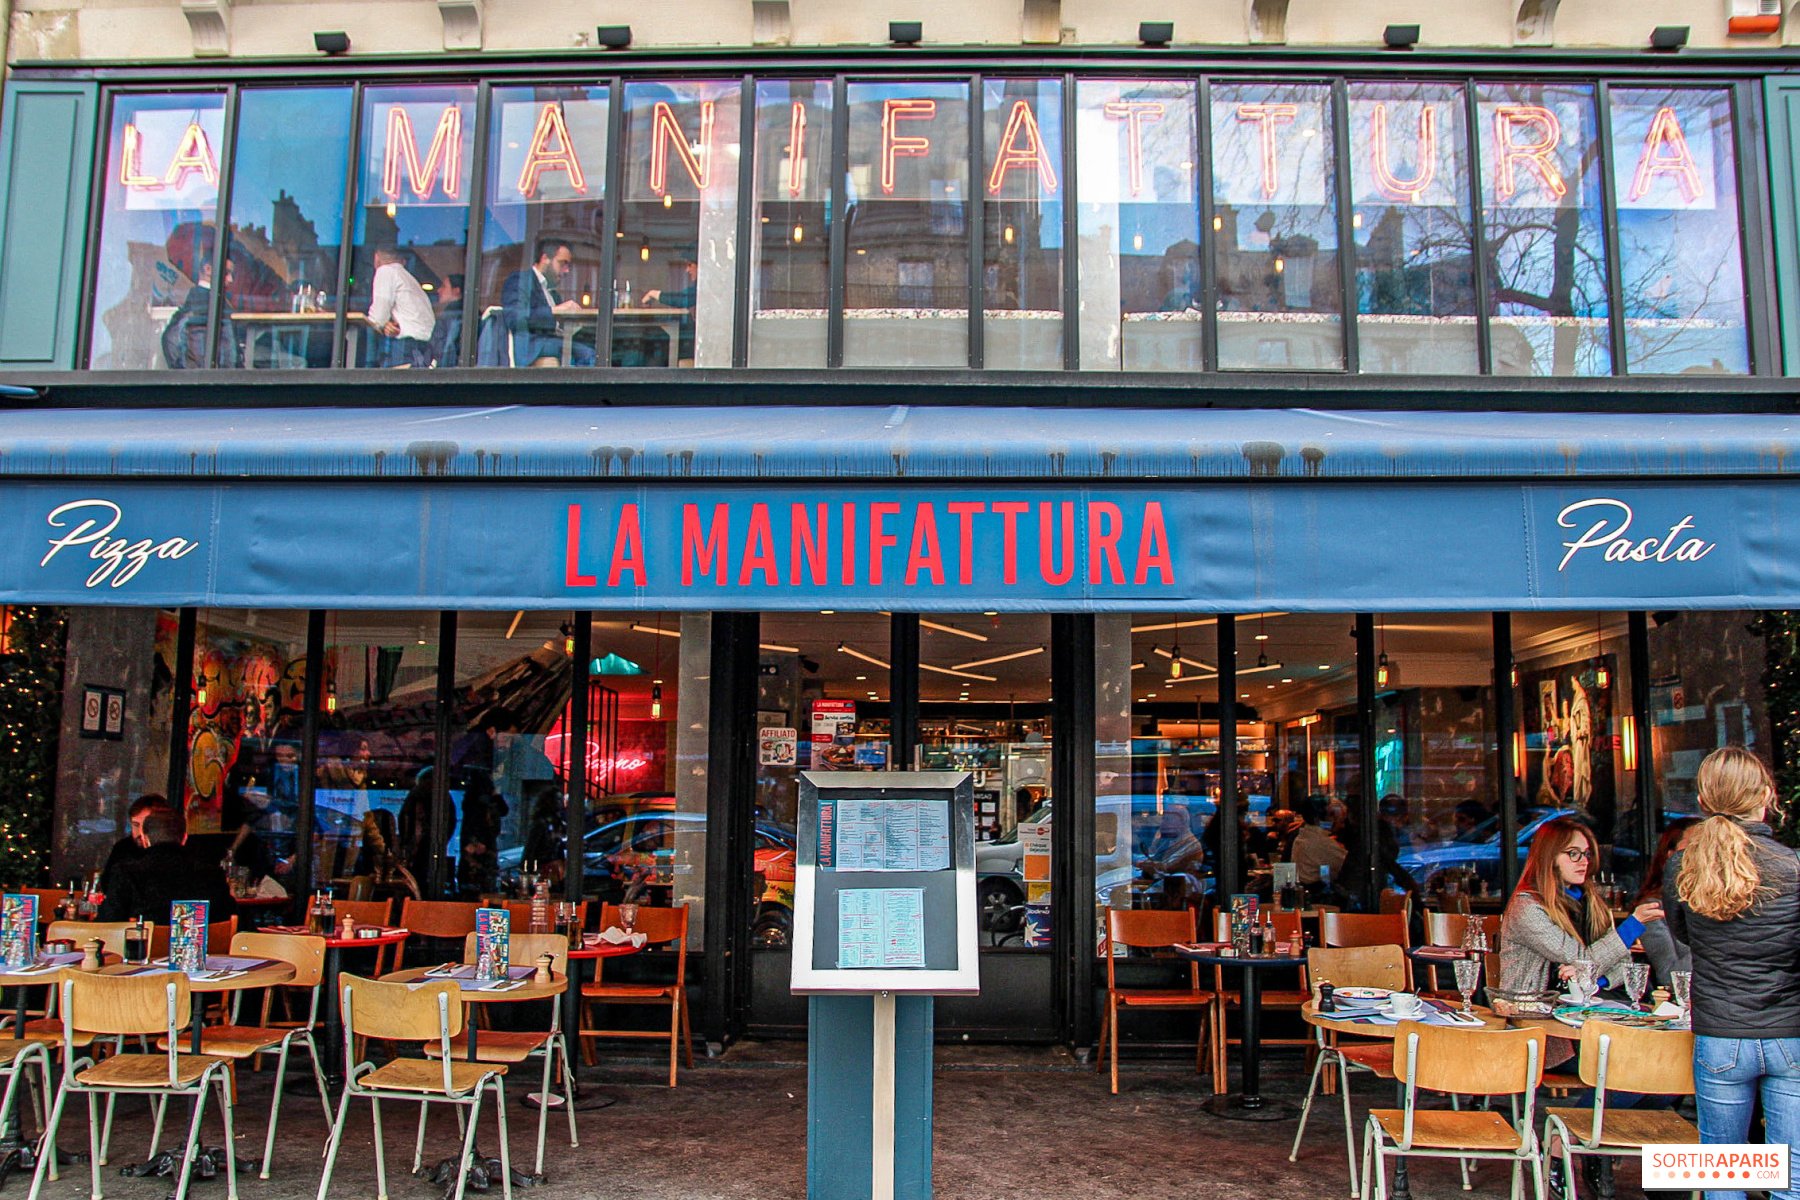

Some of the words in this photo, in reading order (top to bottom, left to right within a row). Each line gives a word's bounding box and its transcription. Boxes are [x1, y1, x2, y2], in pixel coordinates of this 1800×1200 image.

[118, 120, 220, 192] LA
[381, 97, 1706, 203] MANIFATTURA
[39, 498, 199, 589] Pizza
[565, 503, 648, 588] LA
[680, 501, 1176, 588] MANIFATTURA
[1557, 497, 1716, 573] Pasta
[761, 729, 796, 738] AFFILIATO
[819, 857, 832, 867] LA
[820, 805, 833, 856] MANIFATTURA
